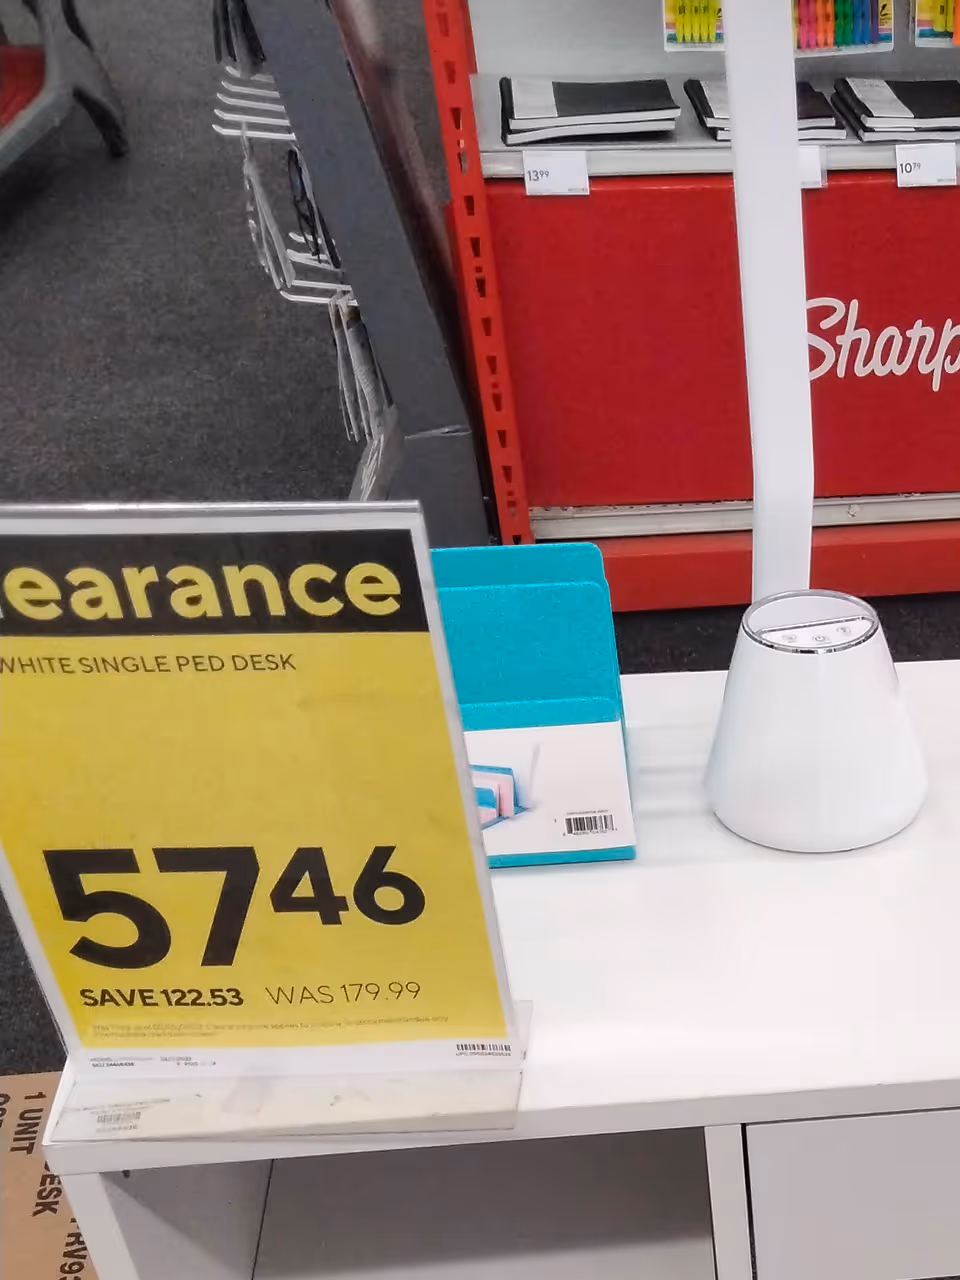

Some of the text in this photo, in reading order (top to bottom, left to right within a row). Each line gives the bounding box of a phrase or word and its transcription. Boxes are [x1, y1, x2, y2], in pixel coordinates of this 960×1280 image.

[0, 562, 401, 621] earance
[0, 653, 297, 674] WHITE SINGLE PED DESK
[79, 981, 421, 1008] SAVE 122.53 WAS 179.99
[10, 1091, 47, 1155] 1 UNIT
